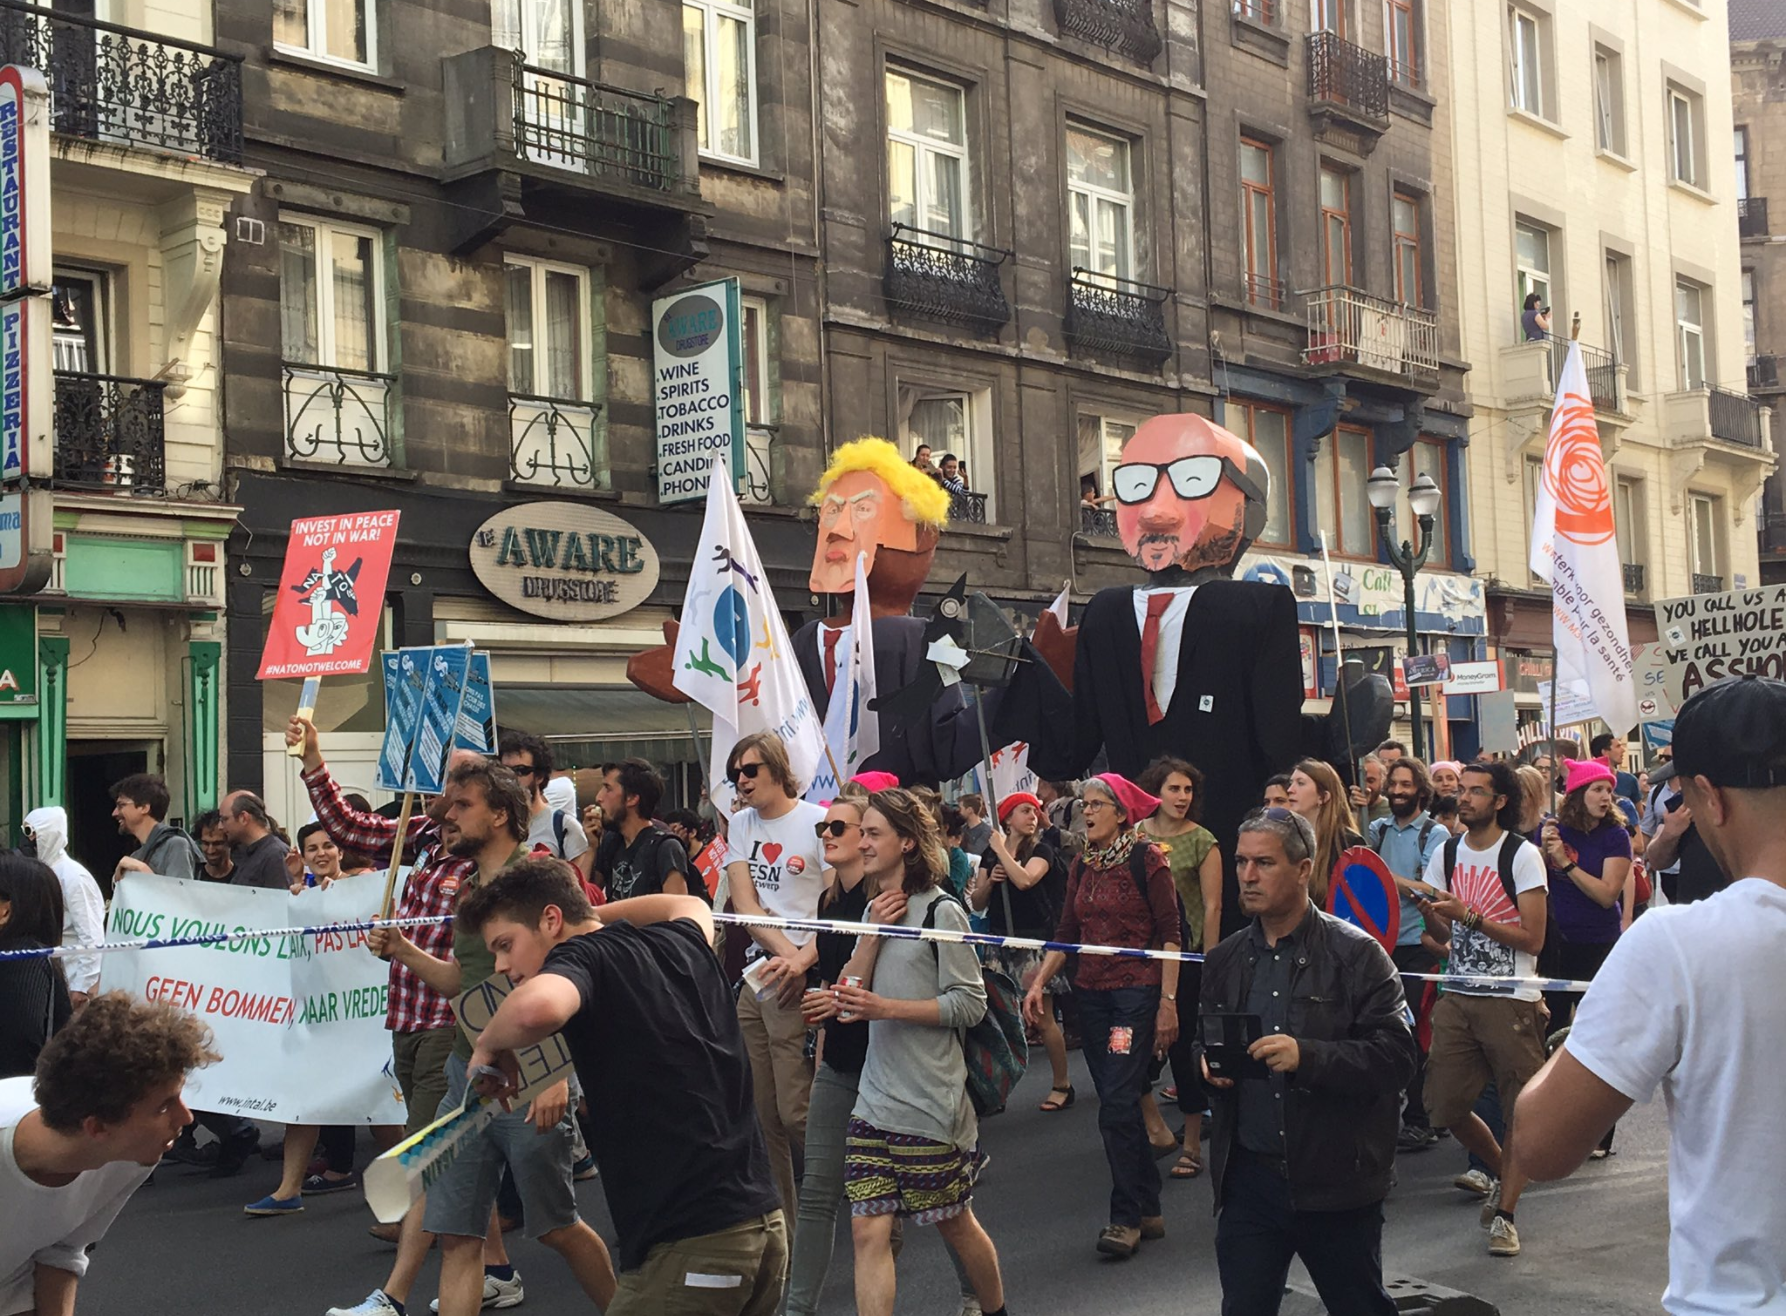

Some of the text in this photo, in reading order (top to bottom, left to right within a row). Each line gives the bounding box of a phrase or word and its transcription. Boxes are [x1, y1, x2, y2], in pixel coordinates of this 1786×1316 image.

[0, 101, 21, 294] RESTAURANT
[667, 308, 719, 338] AWARE
[660, 361, 700, 381] WINE
[3, 313, 22, 470] PIZZERIA
[660, 378, 710, 401] SPIRITS
[659, 394, 730, 420] TOBACCO
[661, 416, 714, 439] DRINKS
[663, 433, 731, 457] FRESH FOOD
[295, 514, 394, 535] INVEST IN PEACE
[303, 529, 382, 547] NOT IN WAR!
[497, 526, 646, 574] AWARE
[523, 576, 621, 604] DRUGSTORE
[1363, 568, 1392, 592] Call
[1663, 599, 1696, 623] YOU
[1704, 594, 1736, 613] CALL
[1743, 591, 1765, 607] US
[1587, 630, 1601, 646] la
[1598, 646, 1626, 683] santé
[1665, 648, 1689, 665] WE
[1694, 642, 1731, 660] CALL
[1739, 636, 1774, 657] YOU
[265, 659, 362, 676] #NATONOTWELCOME
[748, 840, 762, 861] I
[749, 863, 782, 883] ESN
[112, 907, 165, 938] NOUS
[171, 916, 272, 958] VOULONS
[315, 920, 343, 955] PAS
[145, 976, 204, 1013] GEEN
[342, 985, 388, 1020] VREDE
[218, 1095, 278, 1114] www.intal.be
